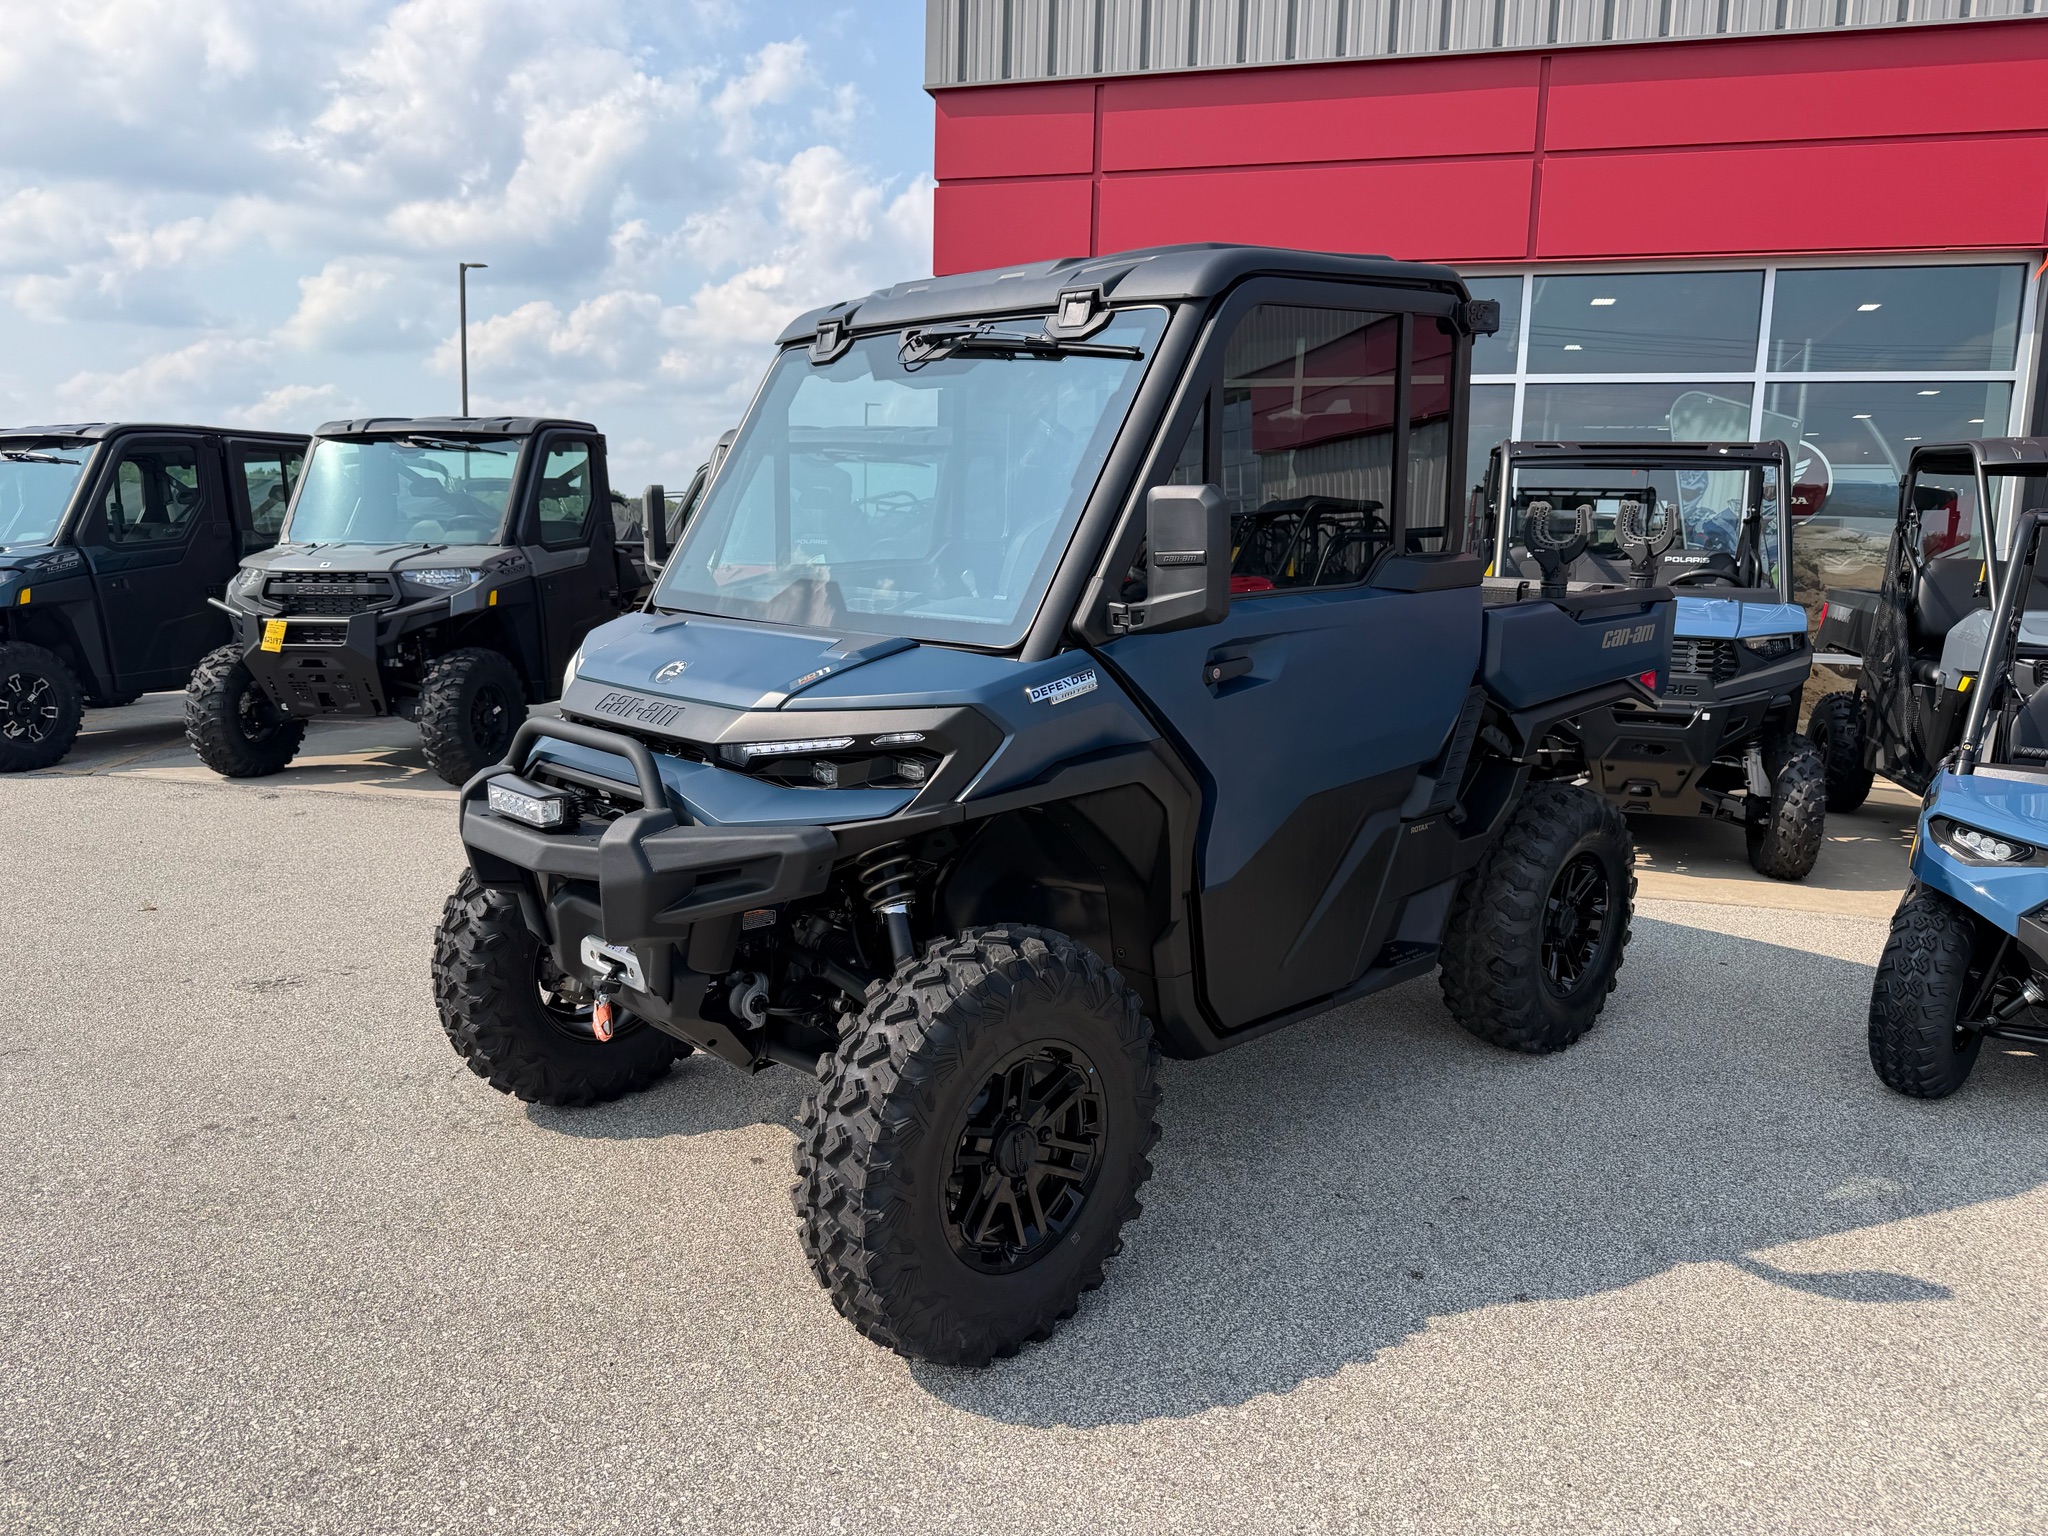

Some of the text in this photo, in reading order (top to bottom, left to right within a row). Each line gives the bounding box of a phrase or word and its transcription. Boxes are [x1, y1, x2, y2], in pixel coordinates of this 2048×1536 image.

[47, 561, 78, 572] 1000
[497, 556, 523, 569] XP
[1664, 556, 1710, 564] POLARIS
[1602, 624, 1656, 649] can-am
[1031, 671, 1095, 700] DEFENDER
[595, 692, 686, 727] can-am
